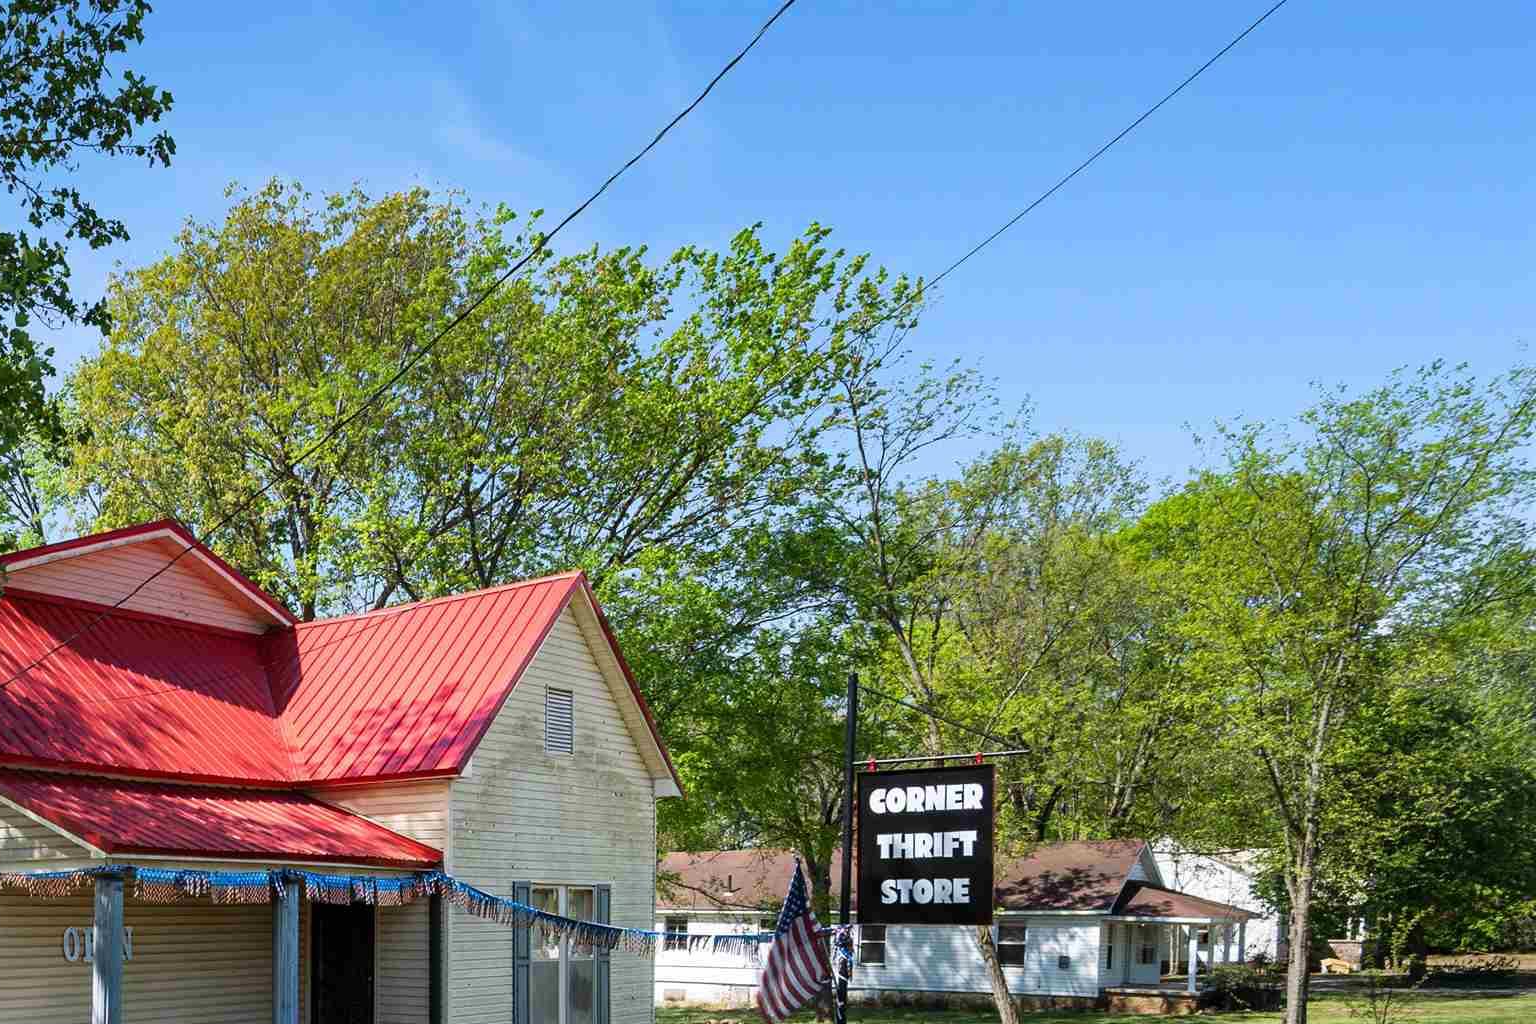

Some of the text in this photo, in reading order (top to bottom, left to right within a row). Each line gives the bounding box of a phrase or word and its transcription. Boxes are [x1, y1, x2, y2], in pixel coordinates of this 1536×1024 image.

[869, 783, 983, 814] CORNER
[877, 830, 977, 859] THRIFT
[881, 878, 970, 904] STORE
[64, 927, 134, 961] OPN
